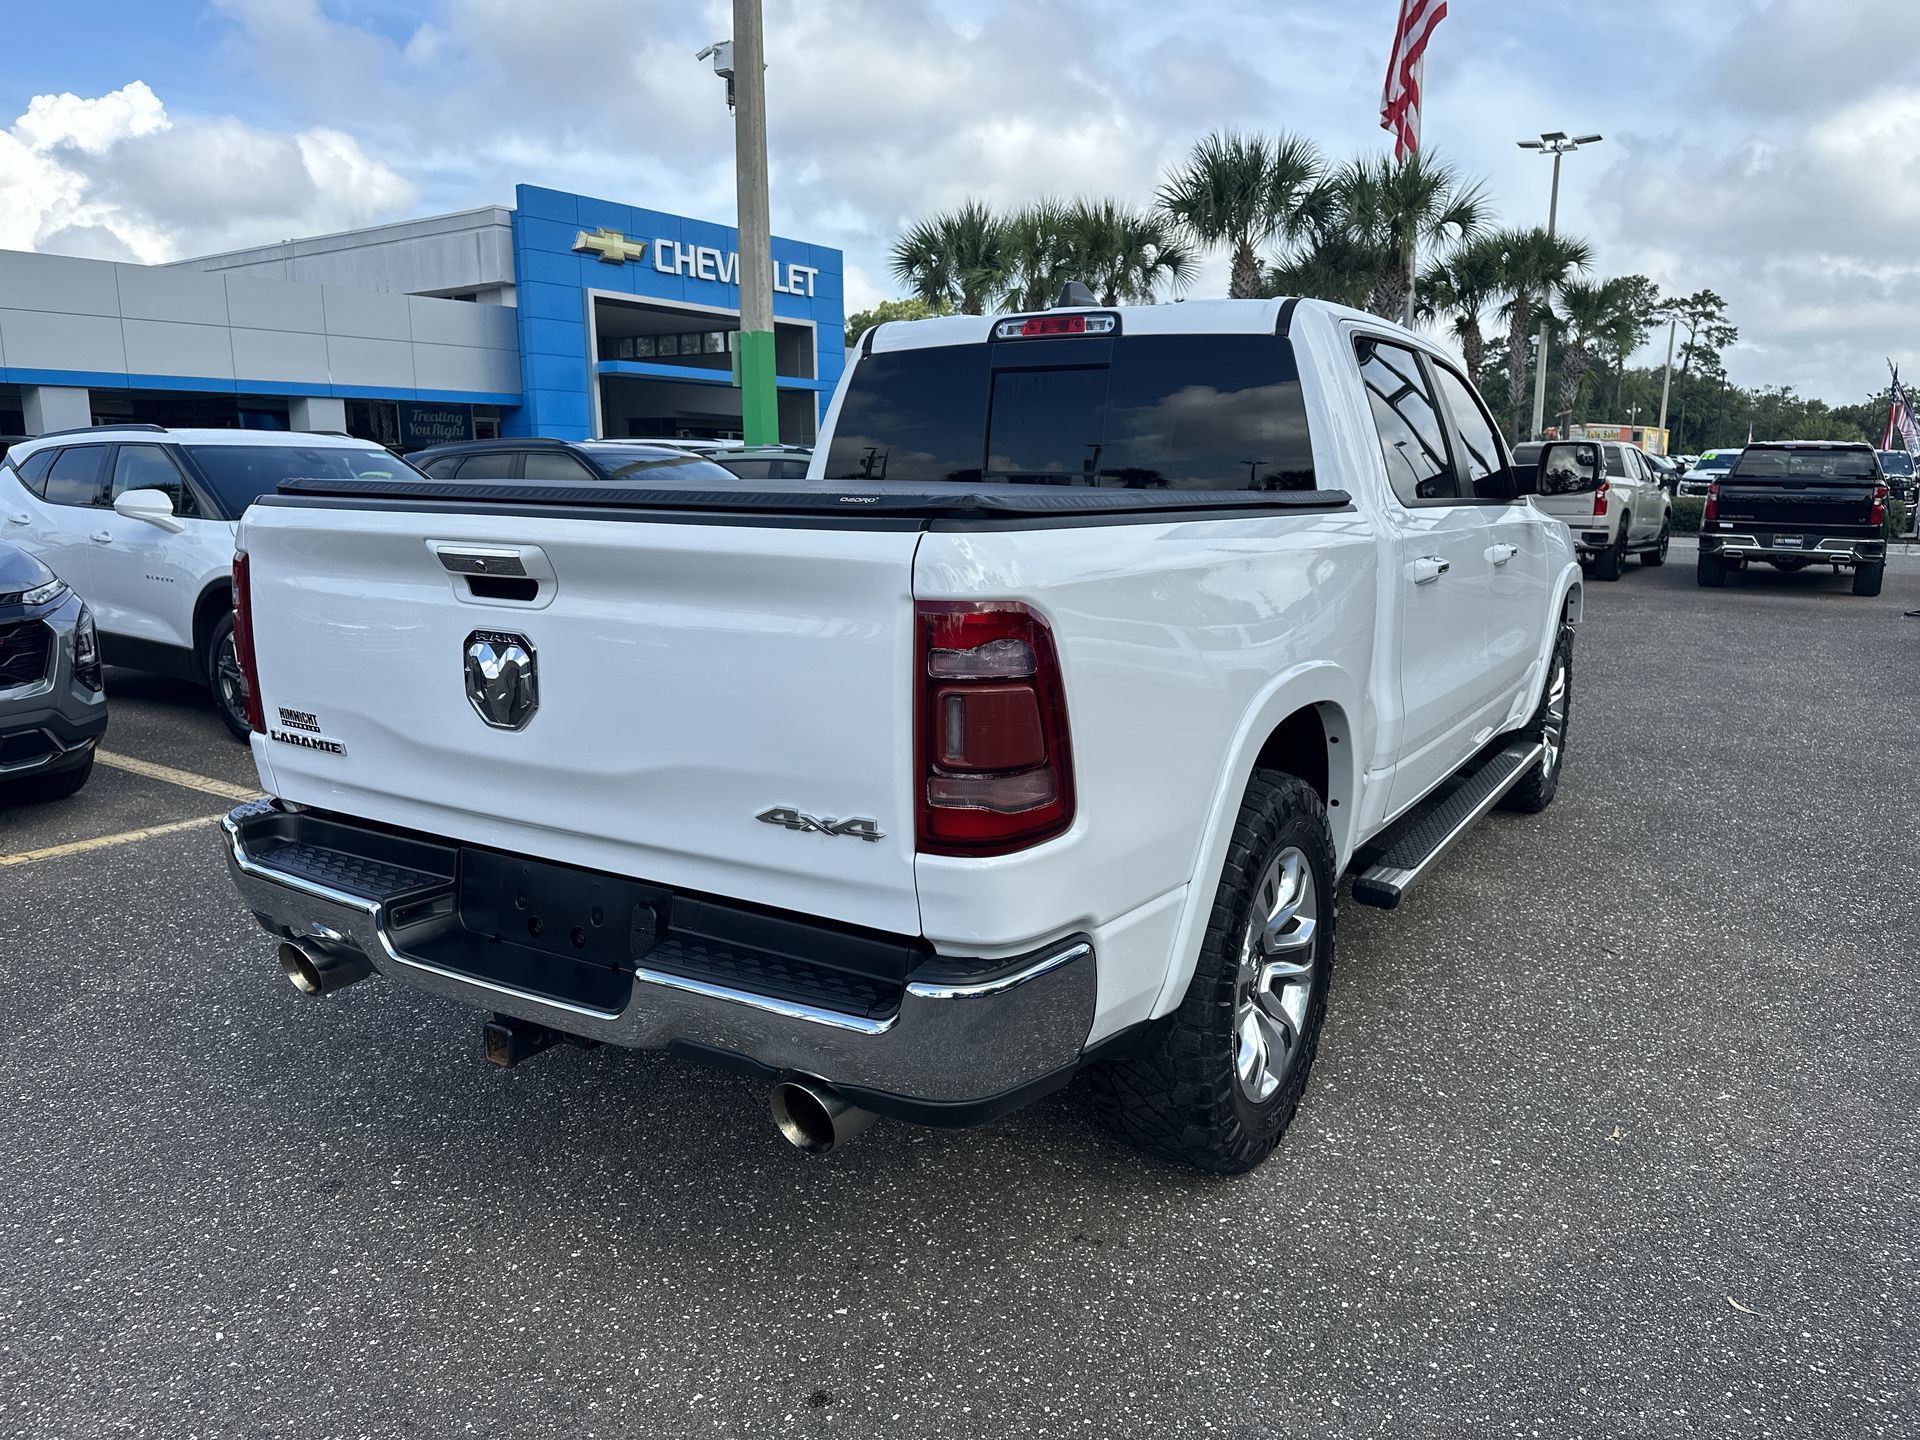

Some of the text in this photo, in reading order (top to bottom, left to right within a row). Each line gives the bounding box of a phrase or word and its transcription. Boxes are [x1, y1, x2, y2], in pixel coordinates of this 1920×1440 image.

[654, 238, 819, 298] CHEVLET
[411, 409, 463, 426] Treating
[409, 422, 465, 439] You Right
[475, 631, 519, 645] RAM
[278, 706, 318, 726] NIMNICHT
[270, 729, 342, 754] LARAMIE
